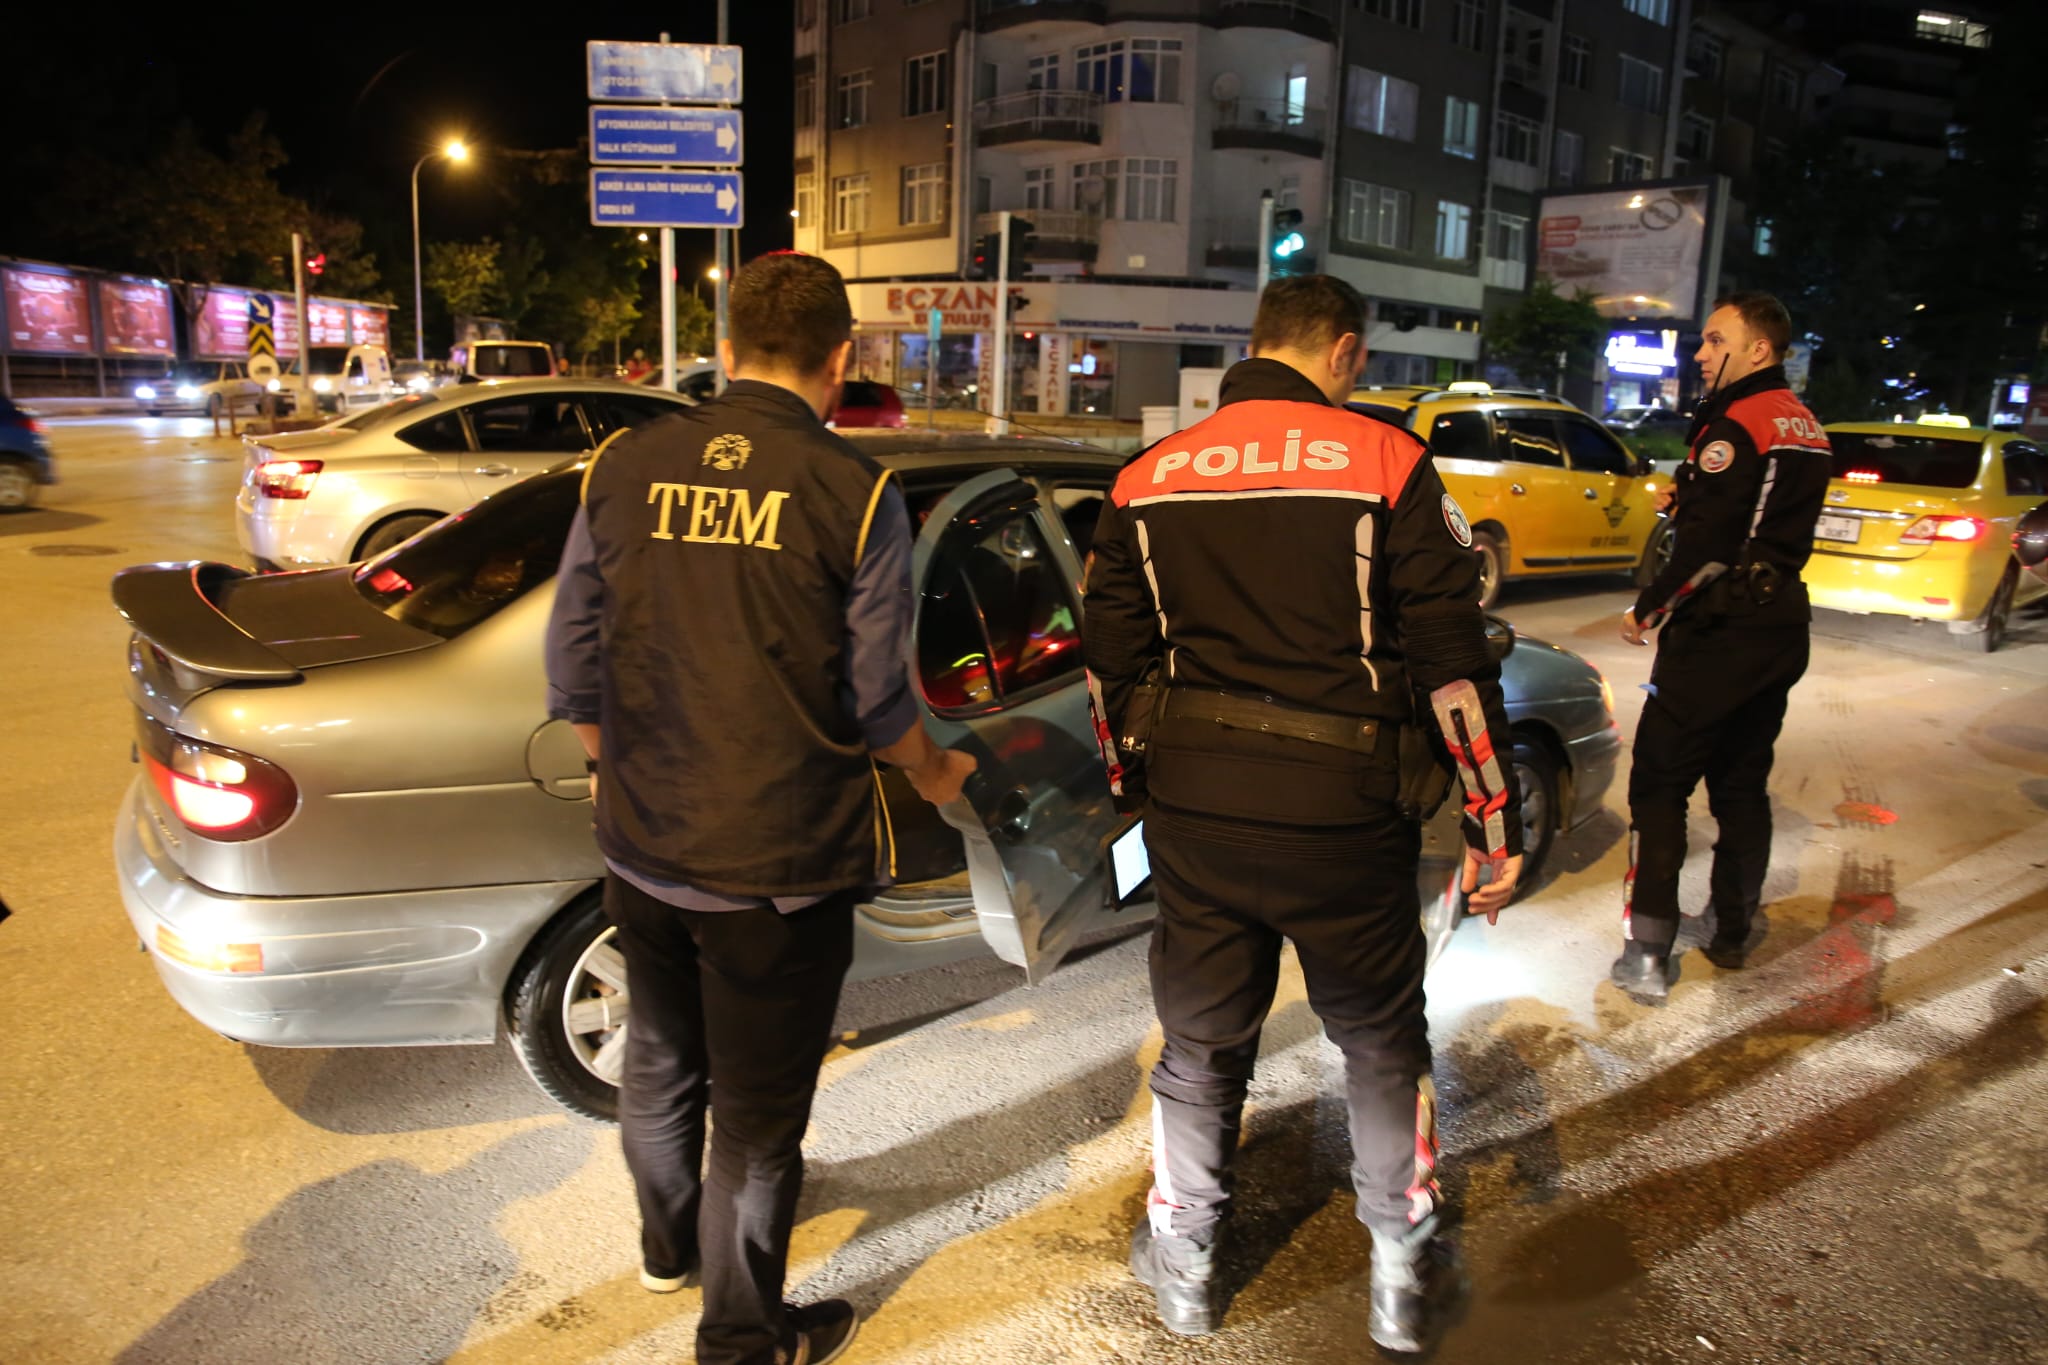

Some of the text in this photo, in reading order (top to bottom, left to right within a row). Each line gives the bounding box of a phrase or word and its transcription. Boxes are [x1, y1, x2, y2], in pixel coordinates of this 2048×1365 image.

[914, 313, 991, 328] KTULUŞ
[980, 337, 991, 411] ECZANE
[1047, 338, 1059, 412] ECZANE
[1152, 429, 1350, 484] POLİS
[647, 482, 791, 550] TEM
